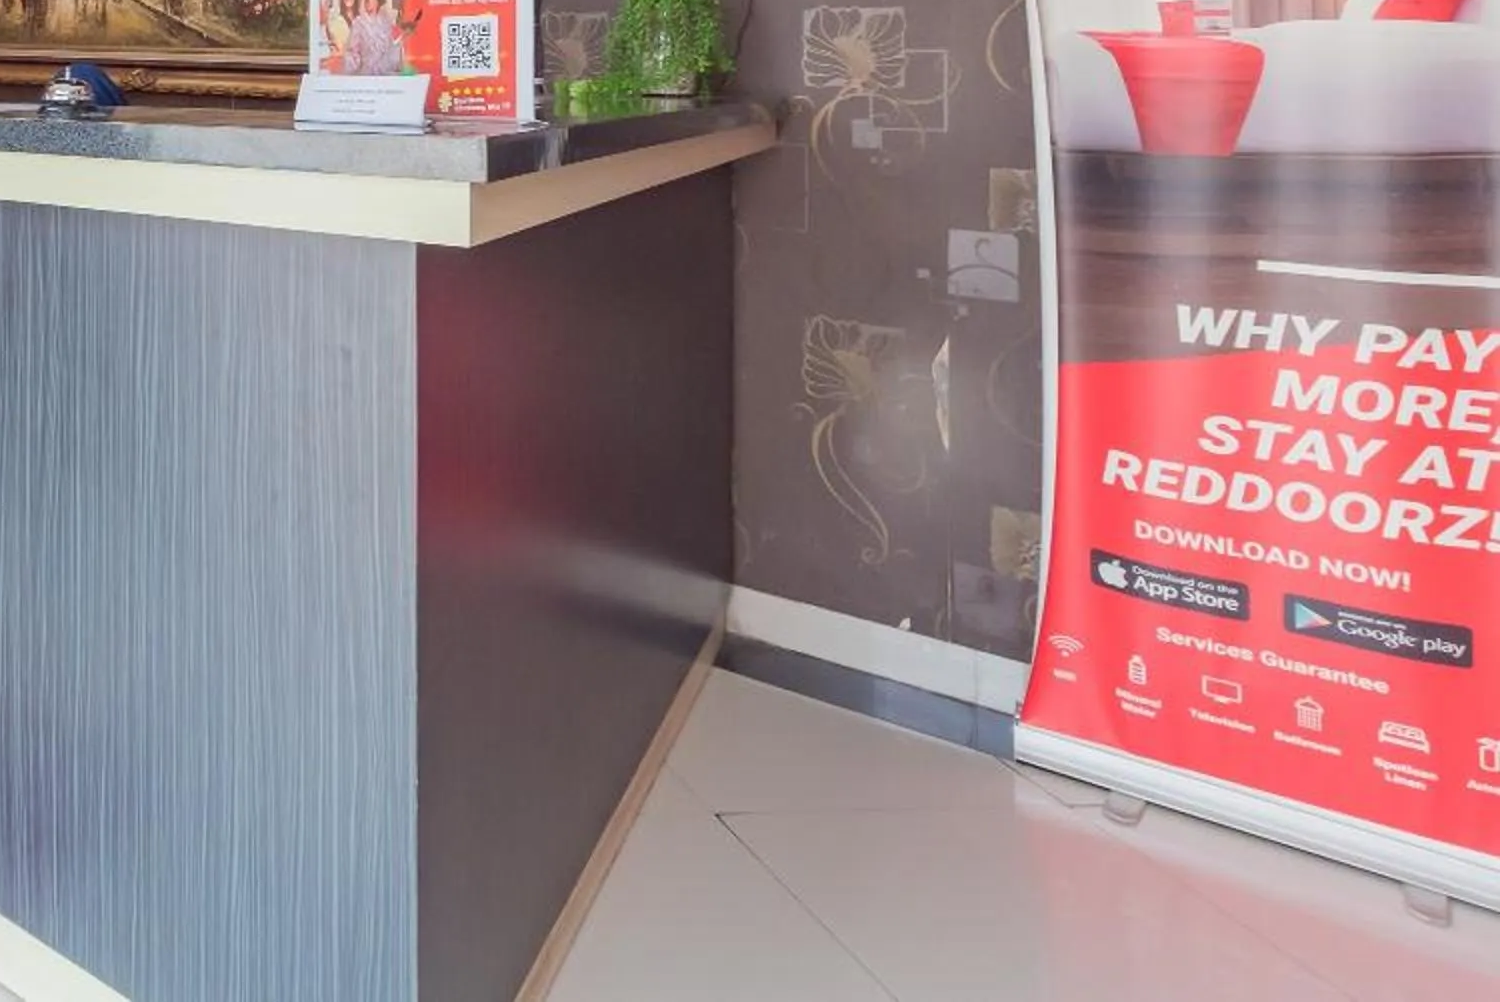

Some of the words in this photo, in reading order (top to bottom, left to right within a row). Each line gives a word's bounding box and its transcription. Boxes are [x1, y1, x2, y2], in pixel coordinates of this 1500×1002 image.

[1175, 304, 1339, 357] WHY
[1354, 323, 1500, 373] PAY
[1198, 415, 1388, 477] STAY
[1397, 445, 1500, 492] AT
[1102, 450, 1500, 553] REDDOORZ!
[1131, 564, 1195, 586] Download
[1133, 520, 1310, 572] DOWNLOAD
[1319, 556, 1412, 592] NOW!
[1133, 576, 1179, 601] App
[1181, 586, 1240, 611] Store
[1156, 627, 1253, 662] Services
[1260, 649, 1391, 695] Guarantee
[1337, 619, 1418, 649] Google
[1423, 636, 1467, 658] play
